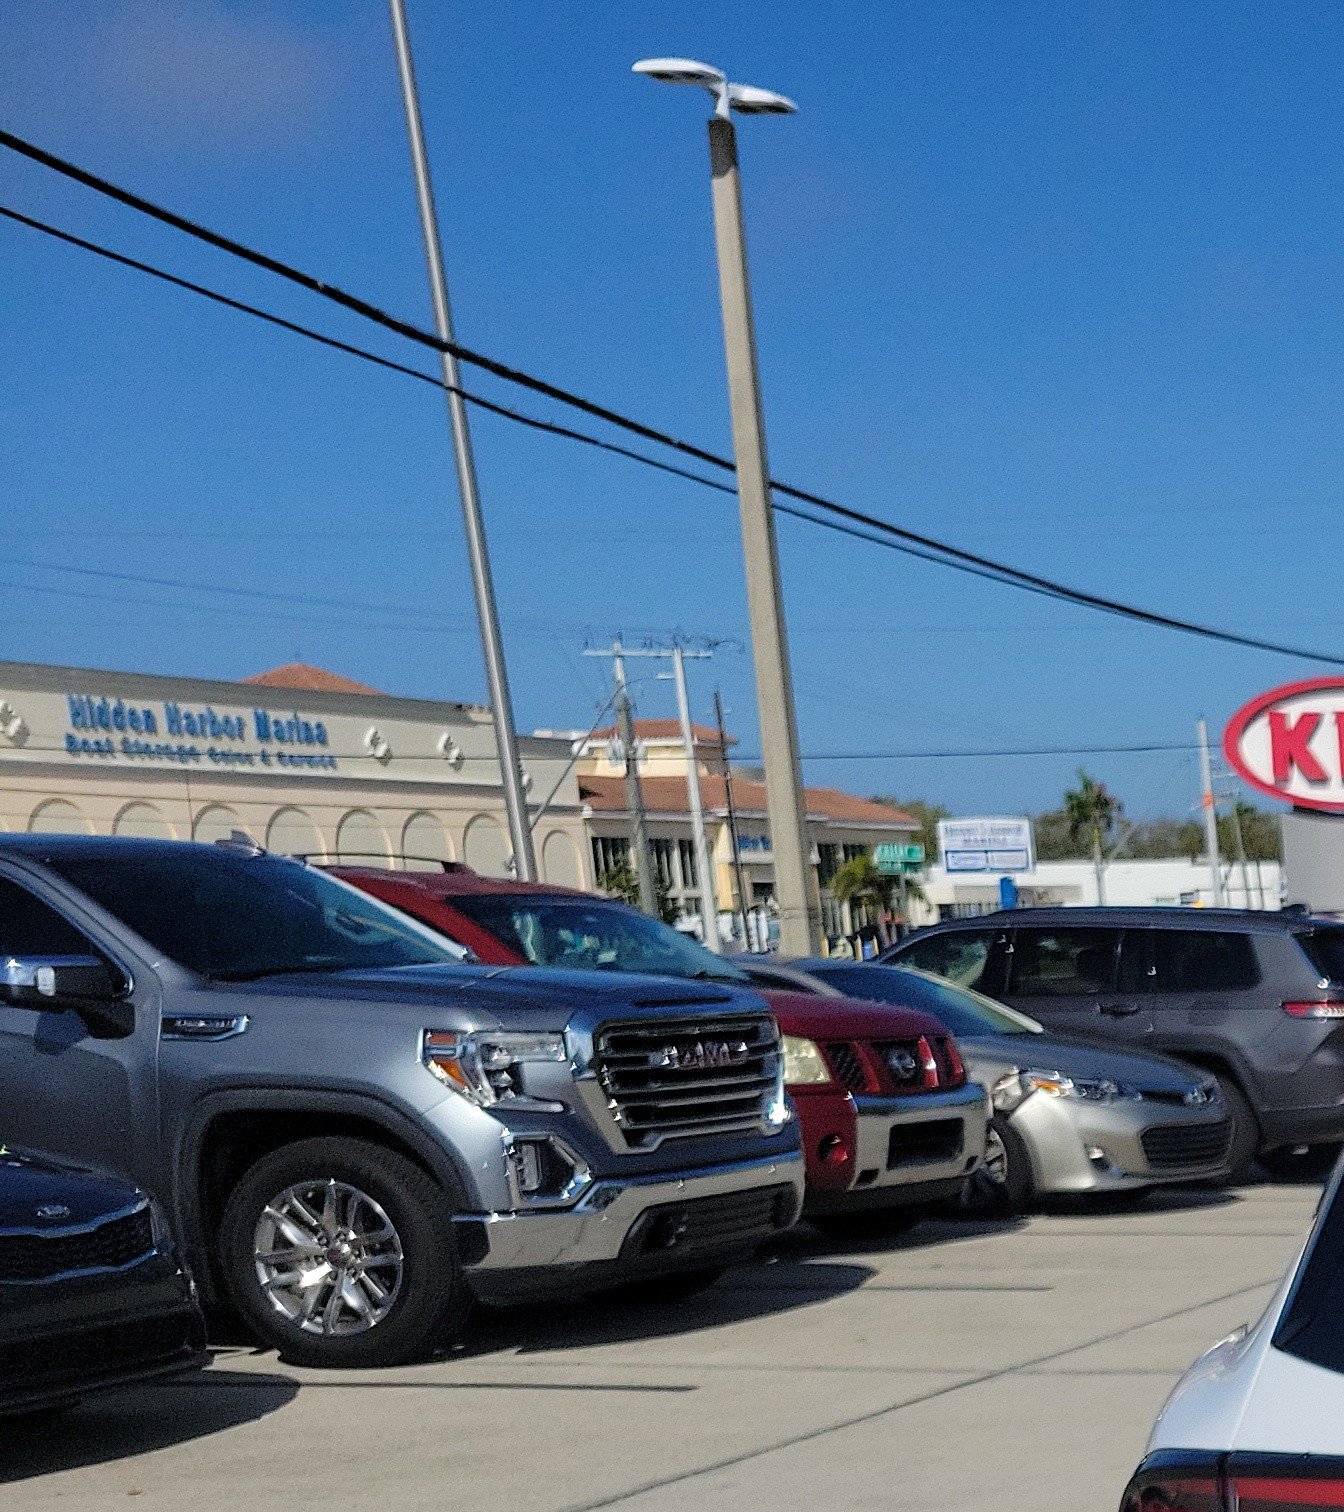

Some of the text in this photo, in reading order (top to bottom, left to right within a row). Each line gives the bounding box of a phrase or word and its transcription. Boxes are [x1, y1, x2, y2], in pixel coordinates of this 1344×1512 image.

[68, 694, 329, 746] Hidden Harbor Marina
